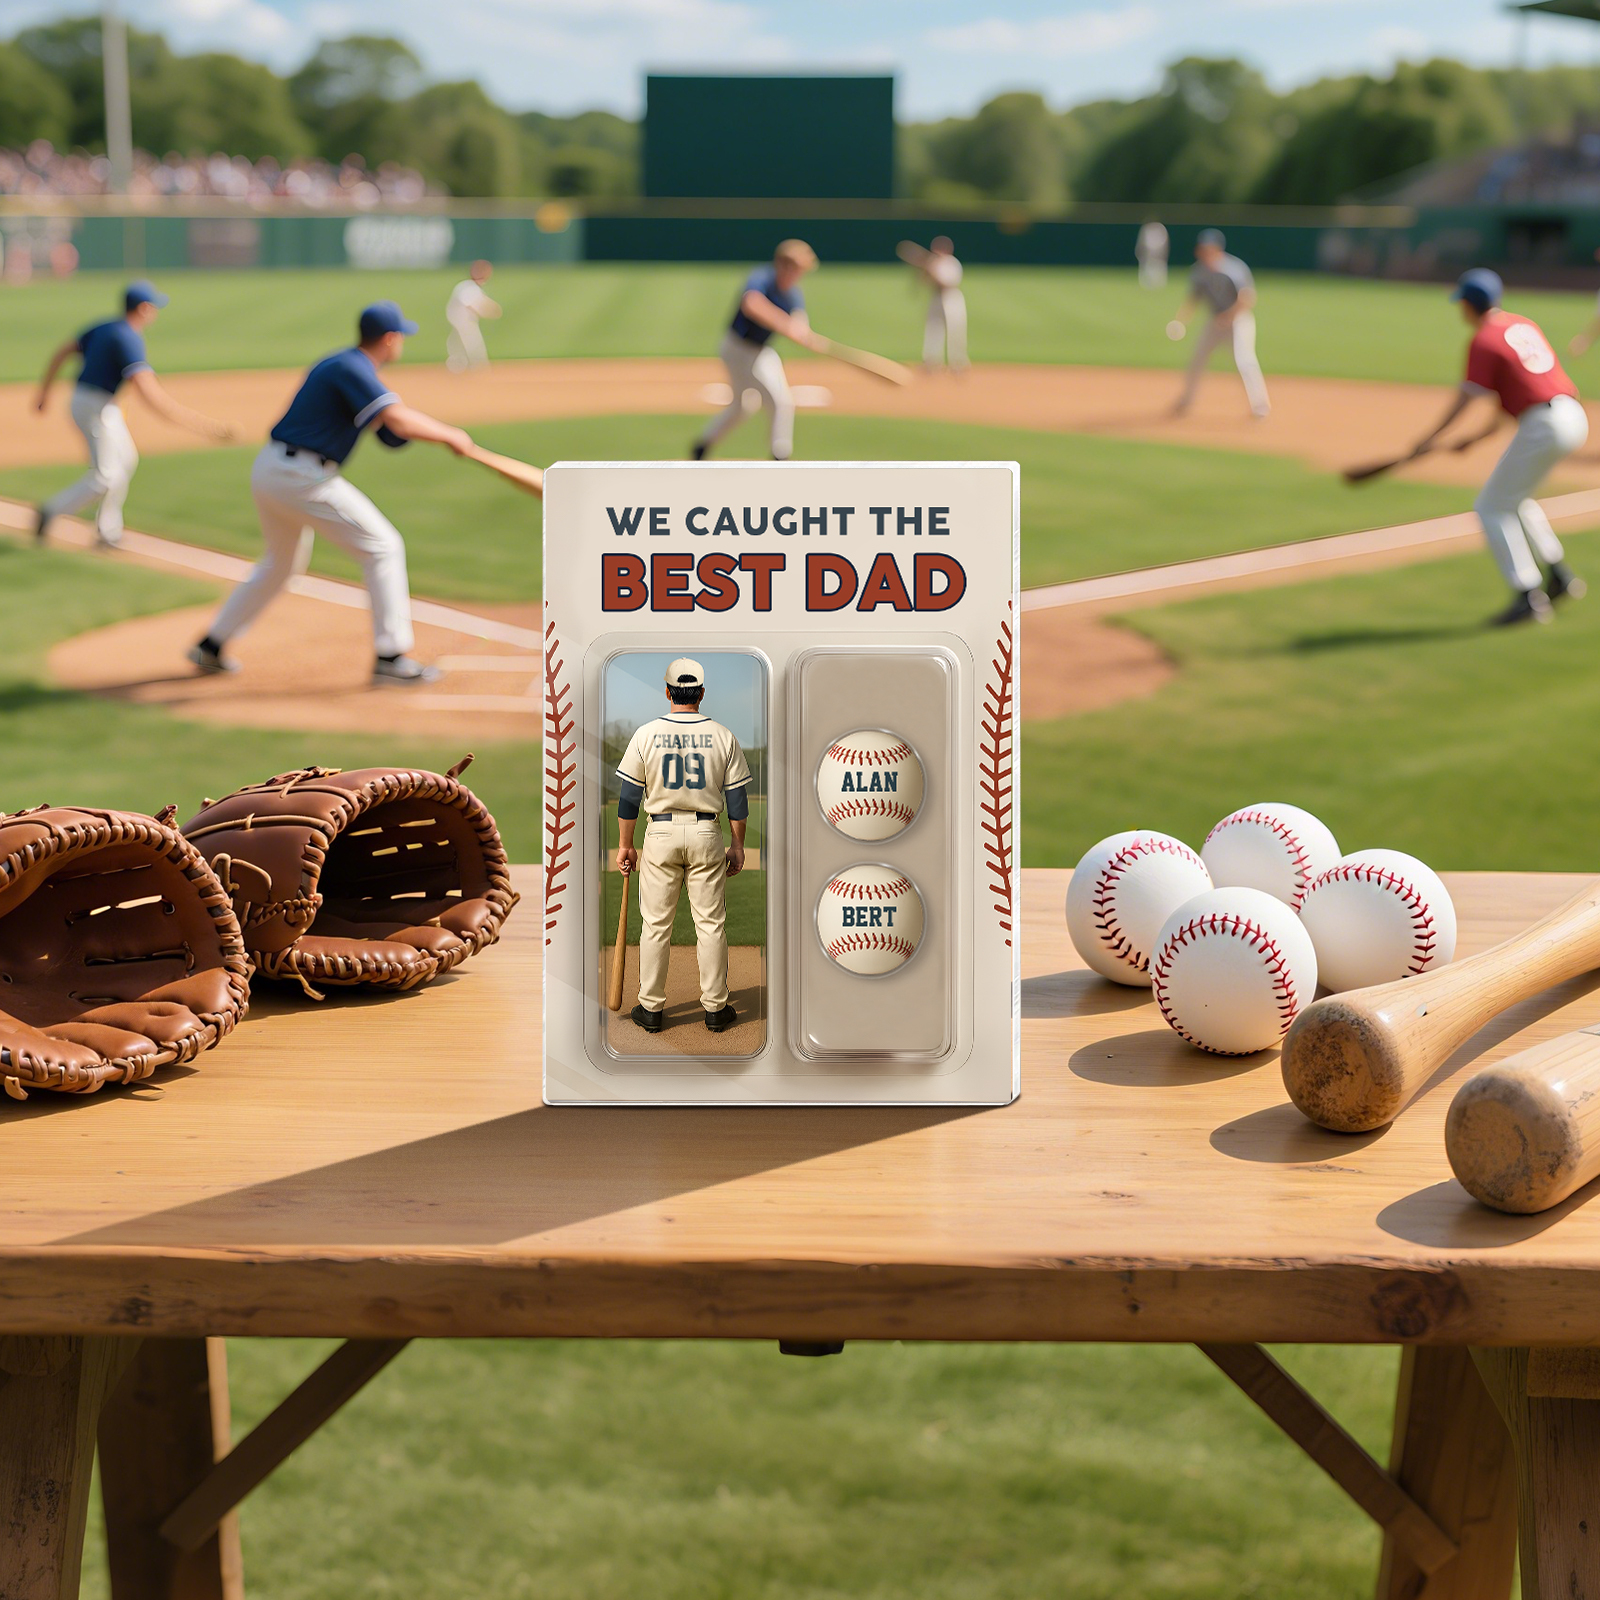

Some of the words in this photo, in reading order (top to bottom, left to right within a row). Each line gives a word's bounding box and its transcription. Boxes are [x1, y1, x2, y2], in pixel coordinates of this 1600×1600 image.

[605, 506, 671, 536] WE
[685, 506, 856, 536] CAUGHT
[869, 506, 950, 536] THE
[601, 552, 786, 612] BEST
[805, 552, 967, 612] DAD
[653, 733, 713, 749] CHARLIE
[662, 752, 706, 790] 09
[841, 771, 898, 792] ALAN
[842, 906, 897, 927] BERT
